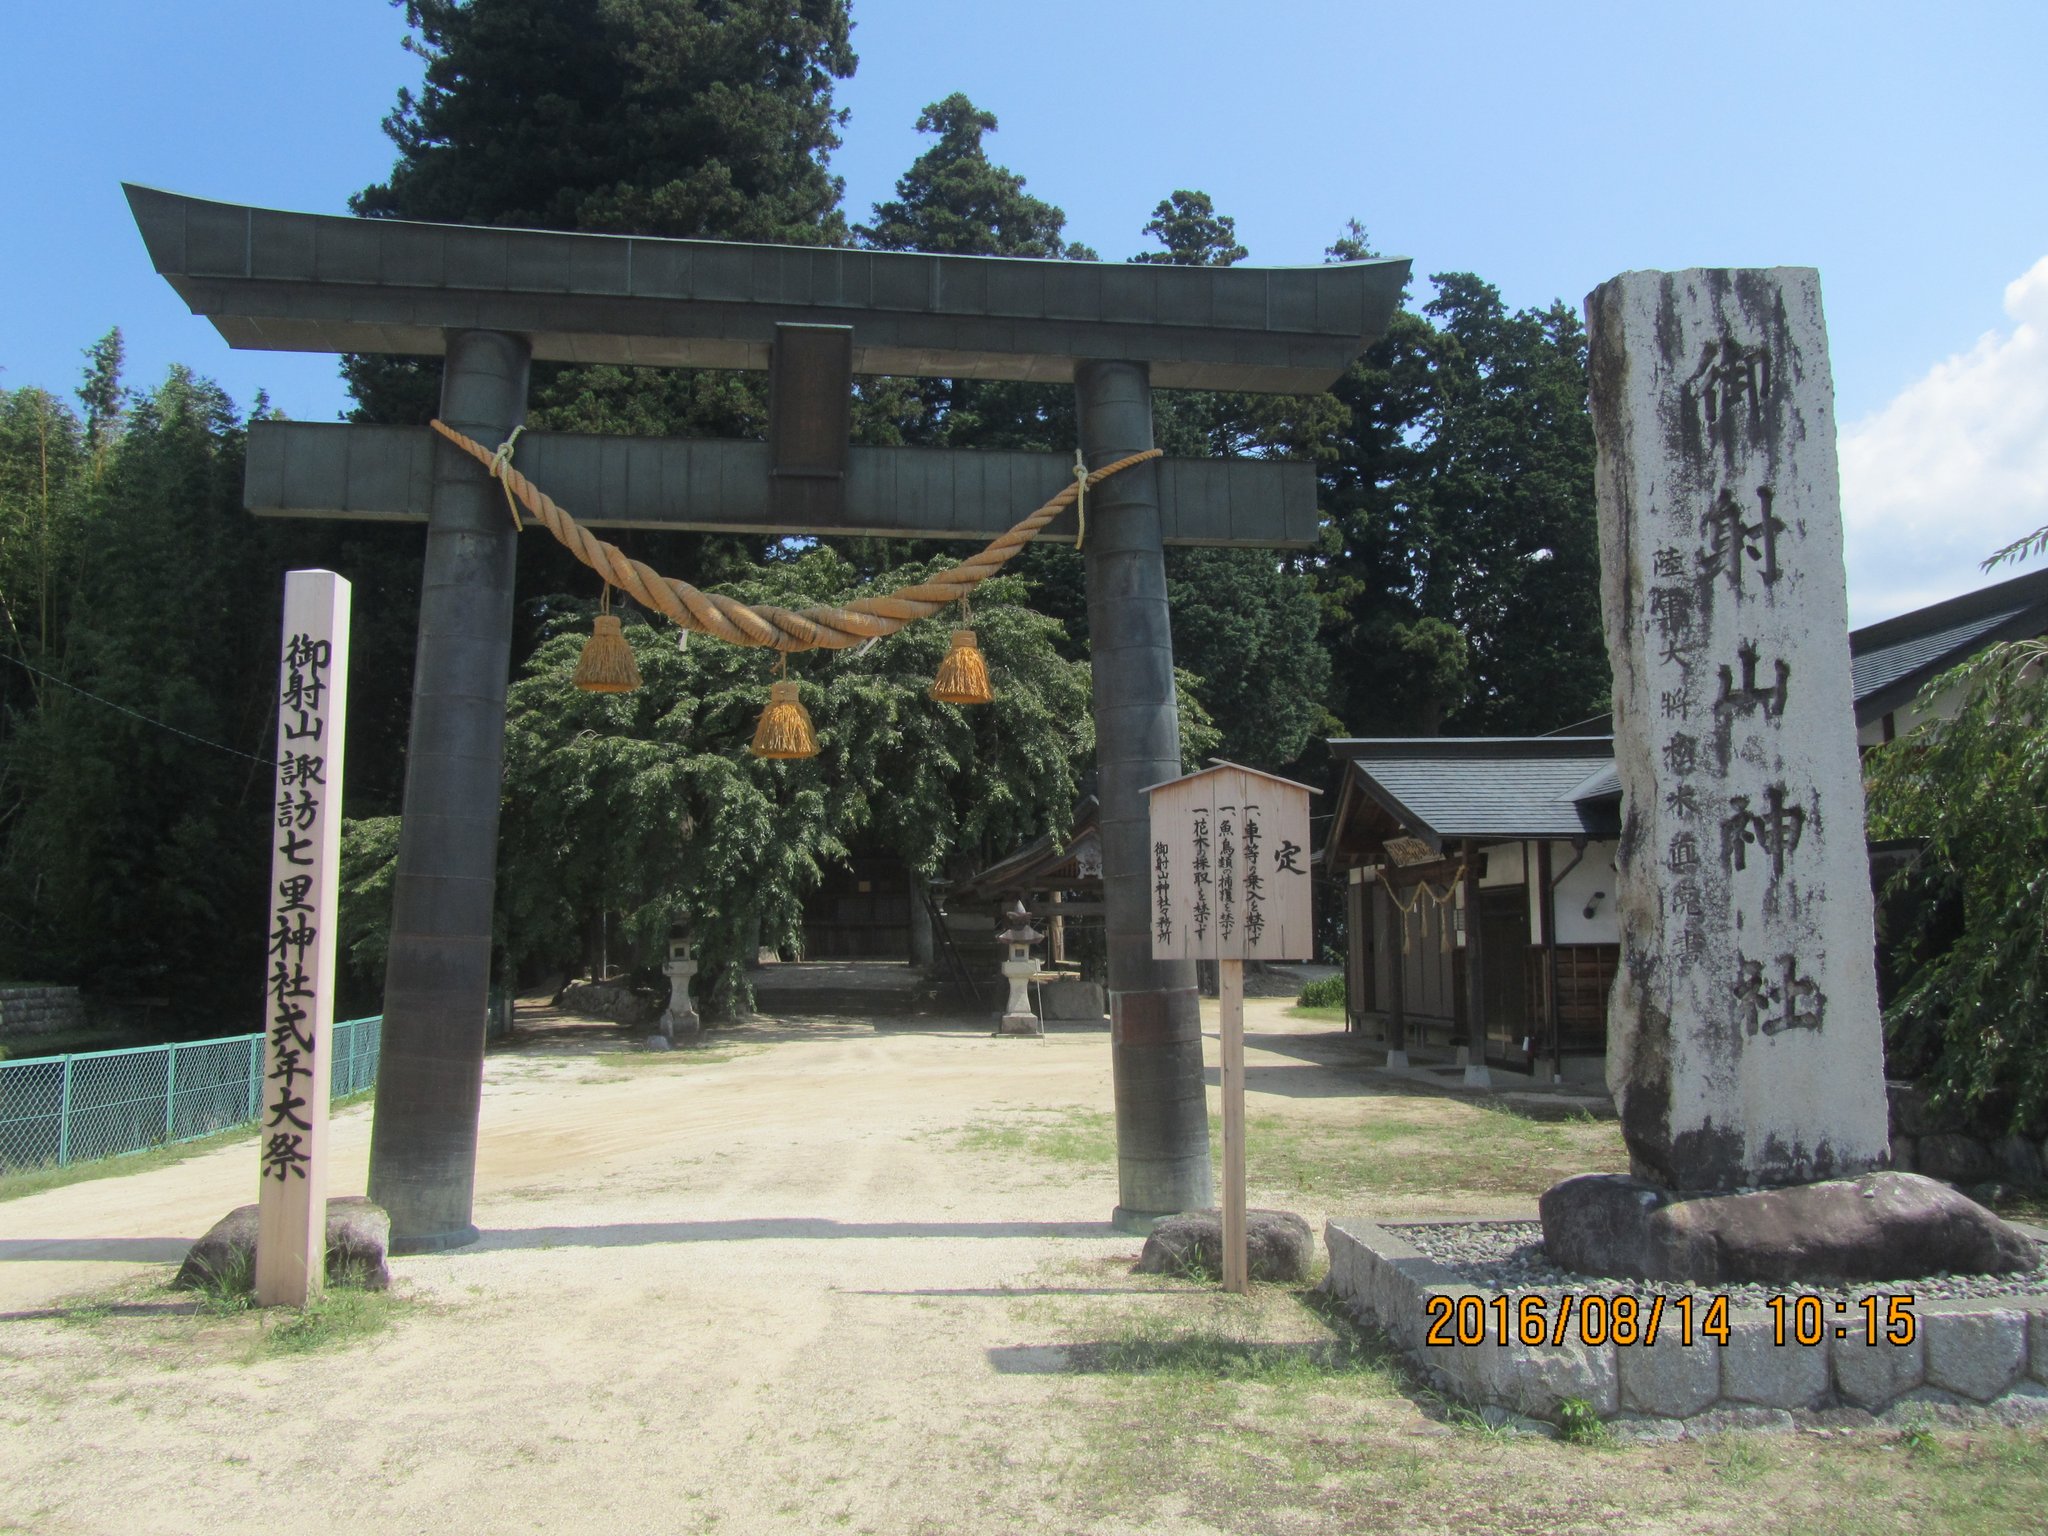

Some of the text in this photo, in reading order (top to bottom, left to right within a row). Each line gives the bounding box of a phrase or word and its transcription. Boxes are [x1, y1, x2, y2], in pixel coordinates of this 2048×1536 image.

[261, 633, 333, 1182] 御射山諏訪七里神社式年大祭
[1274, 840, 1306, 876] 定
[1692, 338, 1822, 1038] 御射山神社
